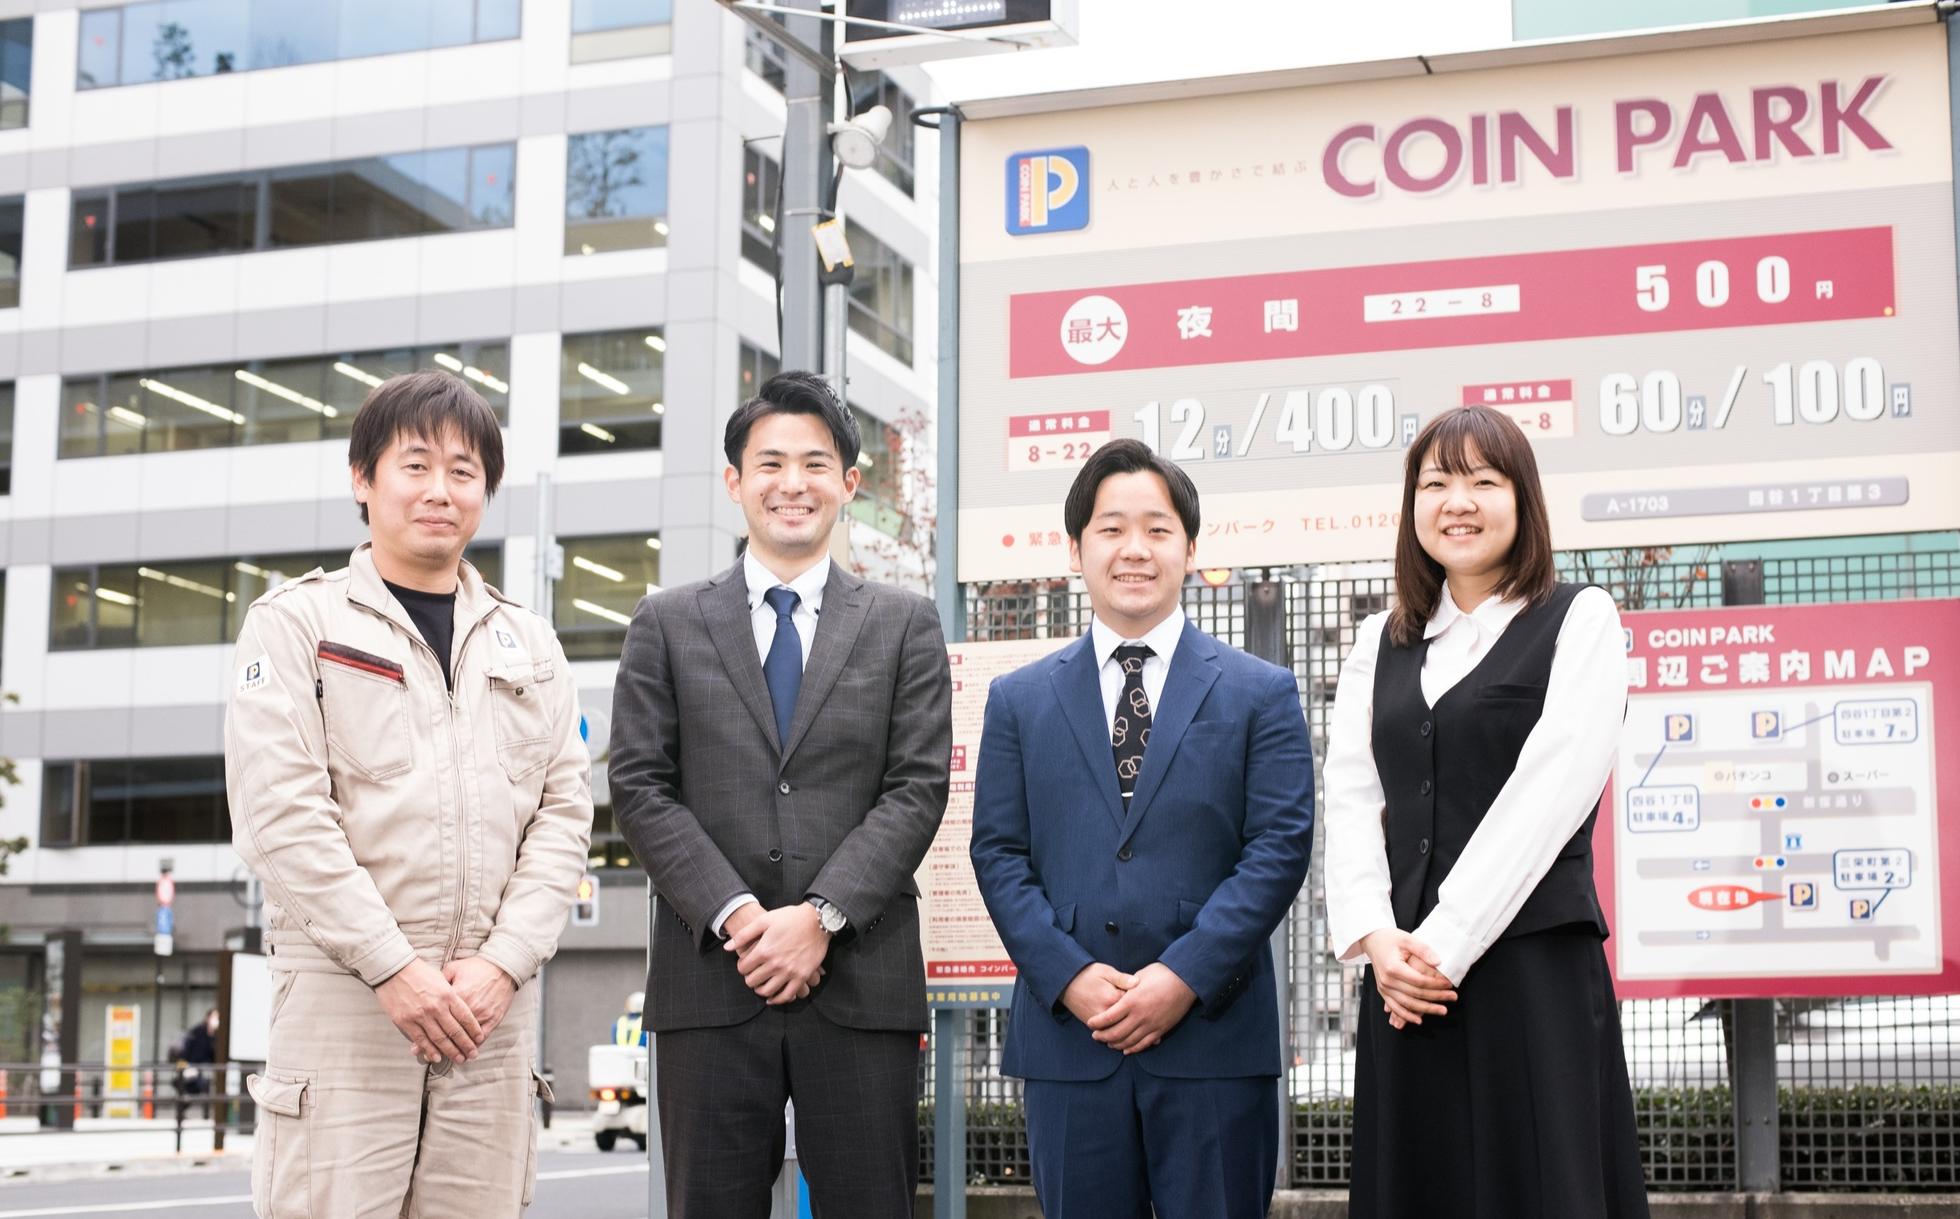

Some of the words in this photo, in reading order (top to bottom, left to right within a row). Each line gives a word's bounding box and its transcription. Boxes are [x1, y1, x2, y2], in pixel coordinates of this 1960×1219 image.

[1322, 106, 1574, 198] COIN
[1614, 75, 1894, 173] PARK
[1068, 316, 1122, 344] 最大
[1177, 298, 1299, 339] 夜間
[1028, 442, 1091, 462] 8-22
[1607, 495, 1670, 514] A-1703
[1028, 530, 1071, 547] 緊急
[1649, 627, 1706, 649] COIN
[1710, 624, 1775, 646] PARK
